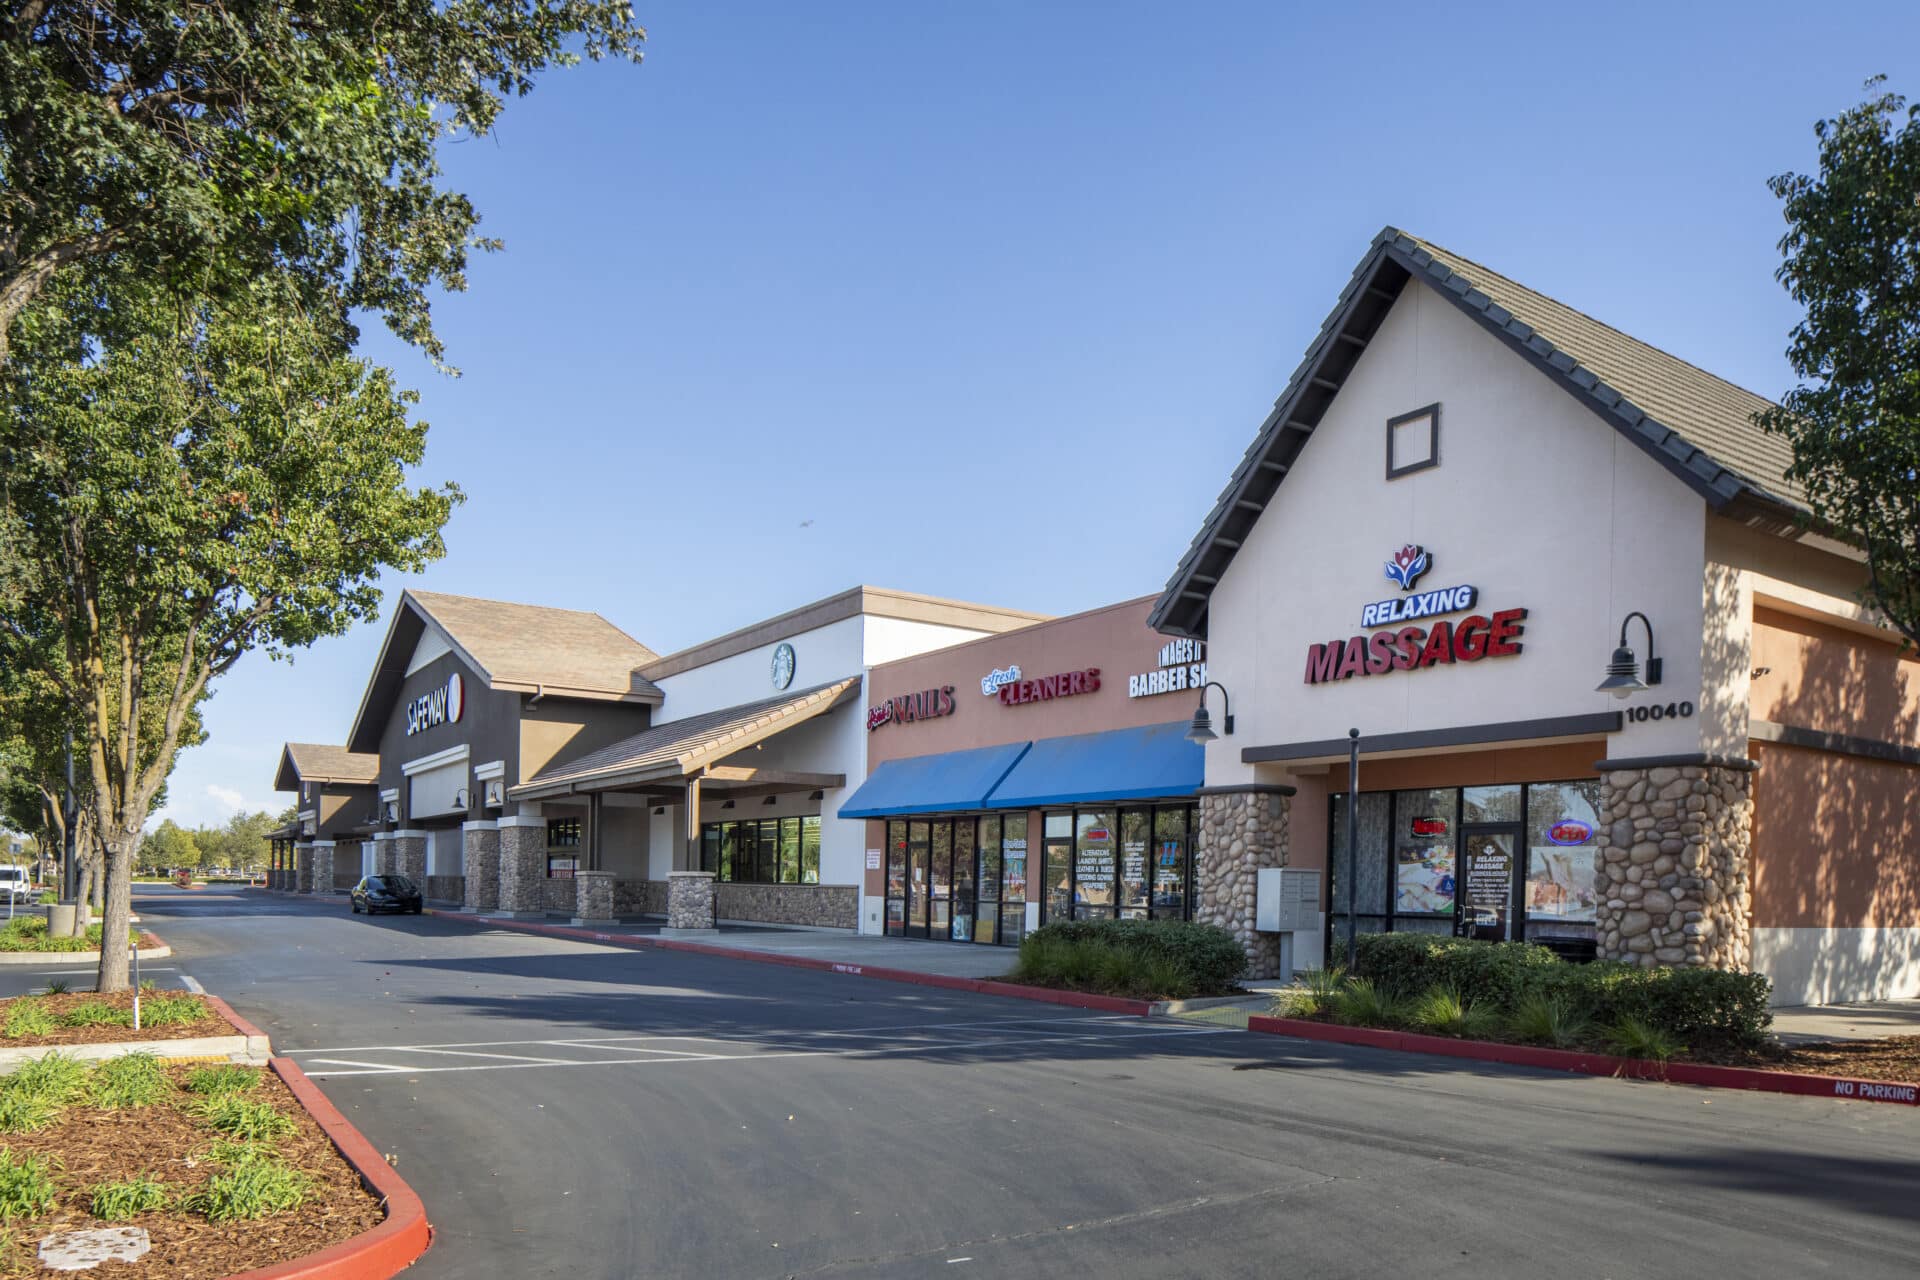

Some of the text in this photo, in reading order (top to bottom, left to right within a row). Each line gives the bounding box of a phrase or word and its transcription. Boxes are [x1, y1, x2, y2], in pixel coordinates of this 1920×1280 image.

[1362, 585, 1473, 627] RELAXING
[1158, 638, 1193, 668] IMAGES
[1304, 608, 1525, 685] MASSAGE
[999, 668, 1100, 705] CLEANERS
[1129, 666, 1187, 698] BARBER
[407, 684, 449, 736] SAFEWAY
[893, 686, 952, 724] NAILS
[1625, 701, 1693, 723] 10040
[1551, 825, 1588, 841] OPEN
[1476, 855, 1508, 863] RELAXING
[1835, 1081, 1916, 1101] NO PARKING
